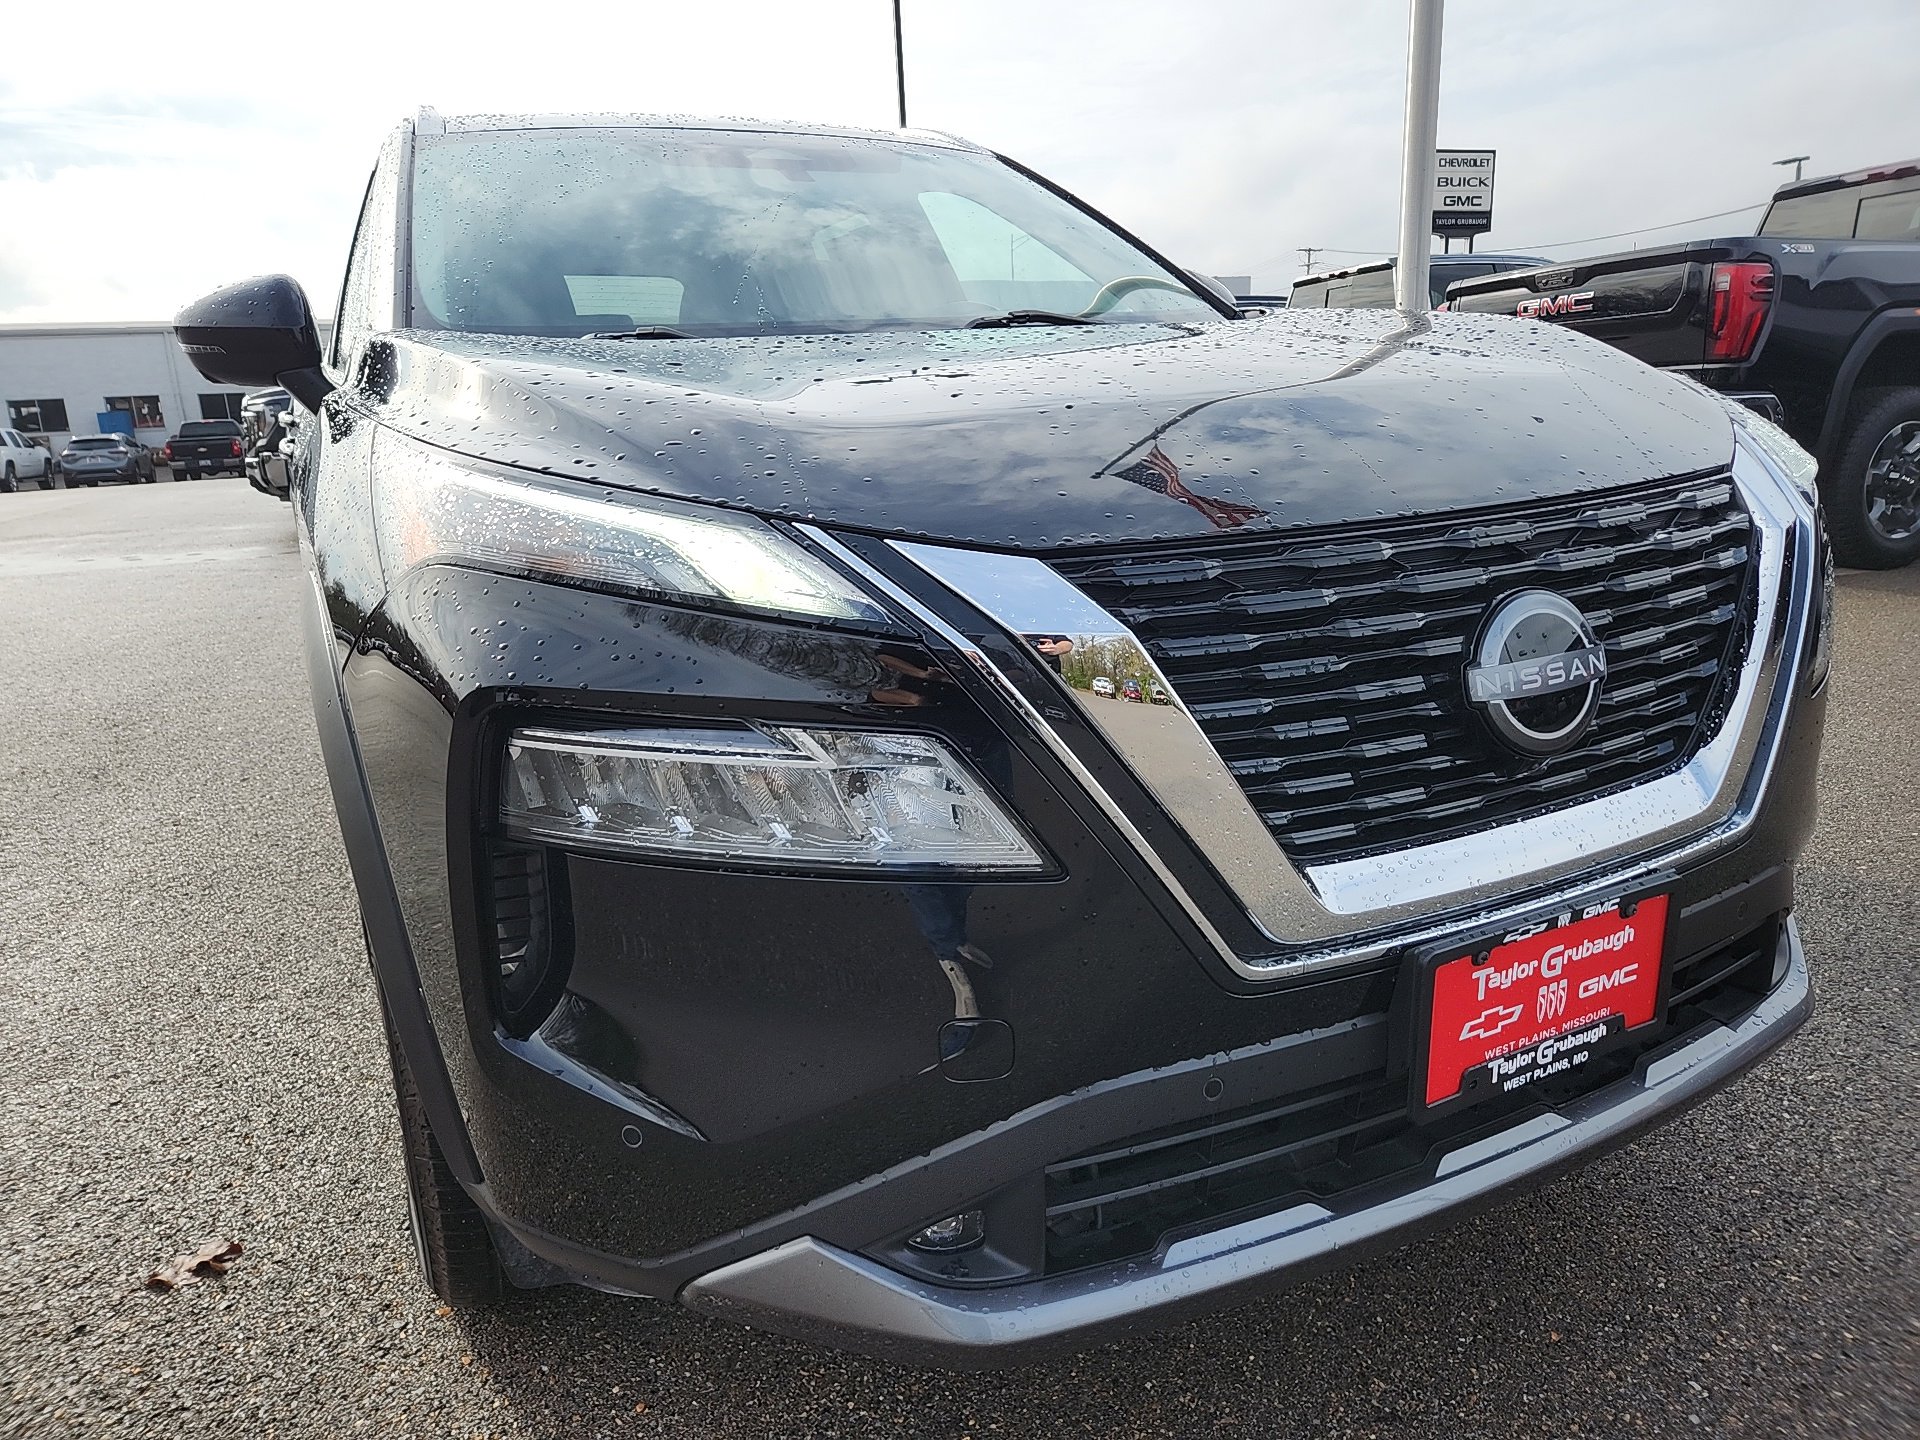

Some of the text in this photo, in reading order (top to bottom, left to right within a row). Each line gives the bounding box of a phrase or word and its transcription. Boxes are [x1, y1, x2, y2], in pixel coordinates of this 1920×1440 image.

[1439, 158, 1491, 168] CHEVROLET
[1437, 176, 1490, 188] BUICK
[1443, 195, 1483, 207] GMC
[1435, 218, 1456, 226] TAYLOR
[1516, 291, 1595, 318] GMC
[1475, 650, 1605, 697] NISSAN
[1582, 898, 1621, 919] GMC
[1472, 925, 1635, 1001] Taylor Grubaugh
[1578, 963, 1639, 999] GMC
[1484, 1006, 1611, 1061] WEST PLAINS, MISSOURI
[1487, 1022, 1607, 1084] Taylor Grubaugh
[1503, 1050, 1589, 1092] WEST PLAINS, MO
